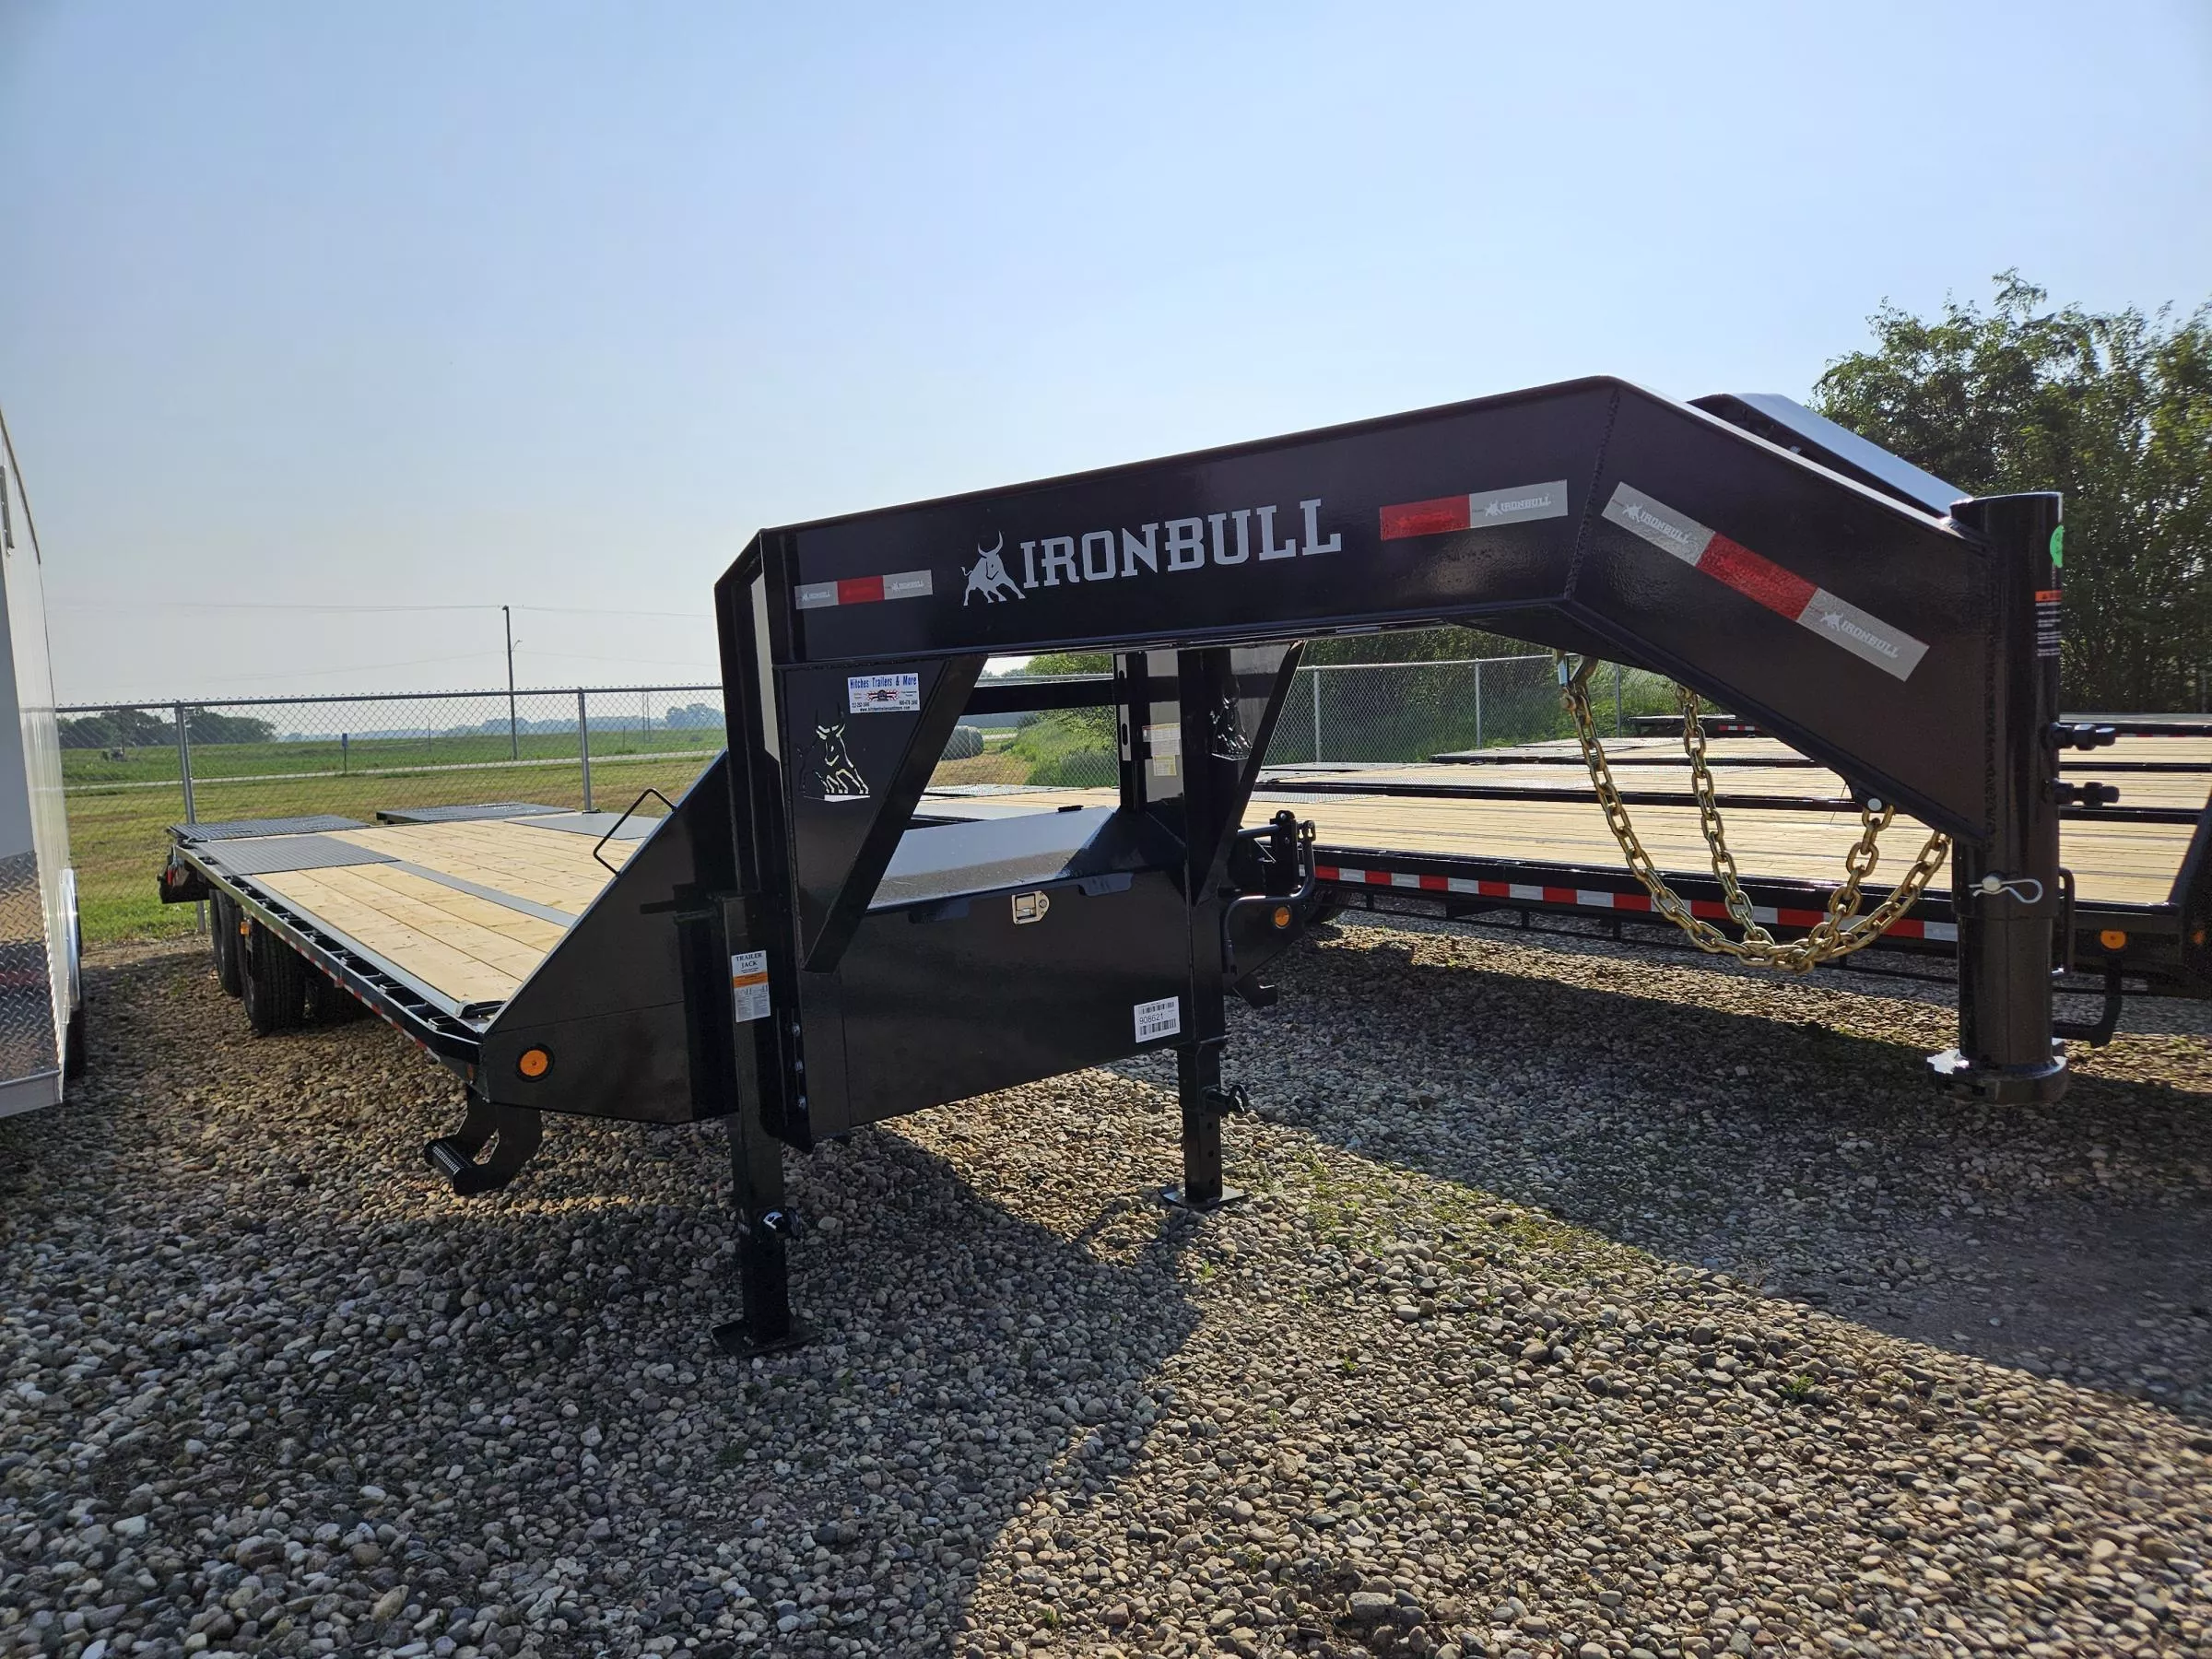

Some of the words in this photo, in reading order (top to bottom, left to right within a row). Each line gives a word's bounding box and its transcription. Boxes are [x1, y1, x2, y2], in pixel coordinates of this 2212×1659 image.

[1500, 494, 1551, 513] IRONBULL
[1640, 510, 1689, 545] IRONBULL
[1019, 498, 1342, 589] IRONBULL
[1841, 619, 1899, 659] IRONBULL
[872, 677, 892, 687] Trailers
[896, 676, 900, 686] &
[903, 675, 916, 686] More
[735, 953, 763, 961] TRAILER
[741, 960, 758, 969] JACK
[1139, 1013, 1164, 1024] 908621
